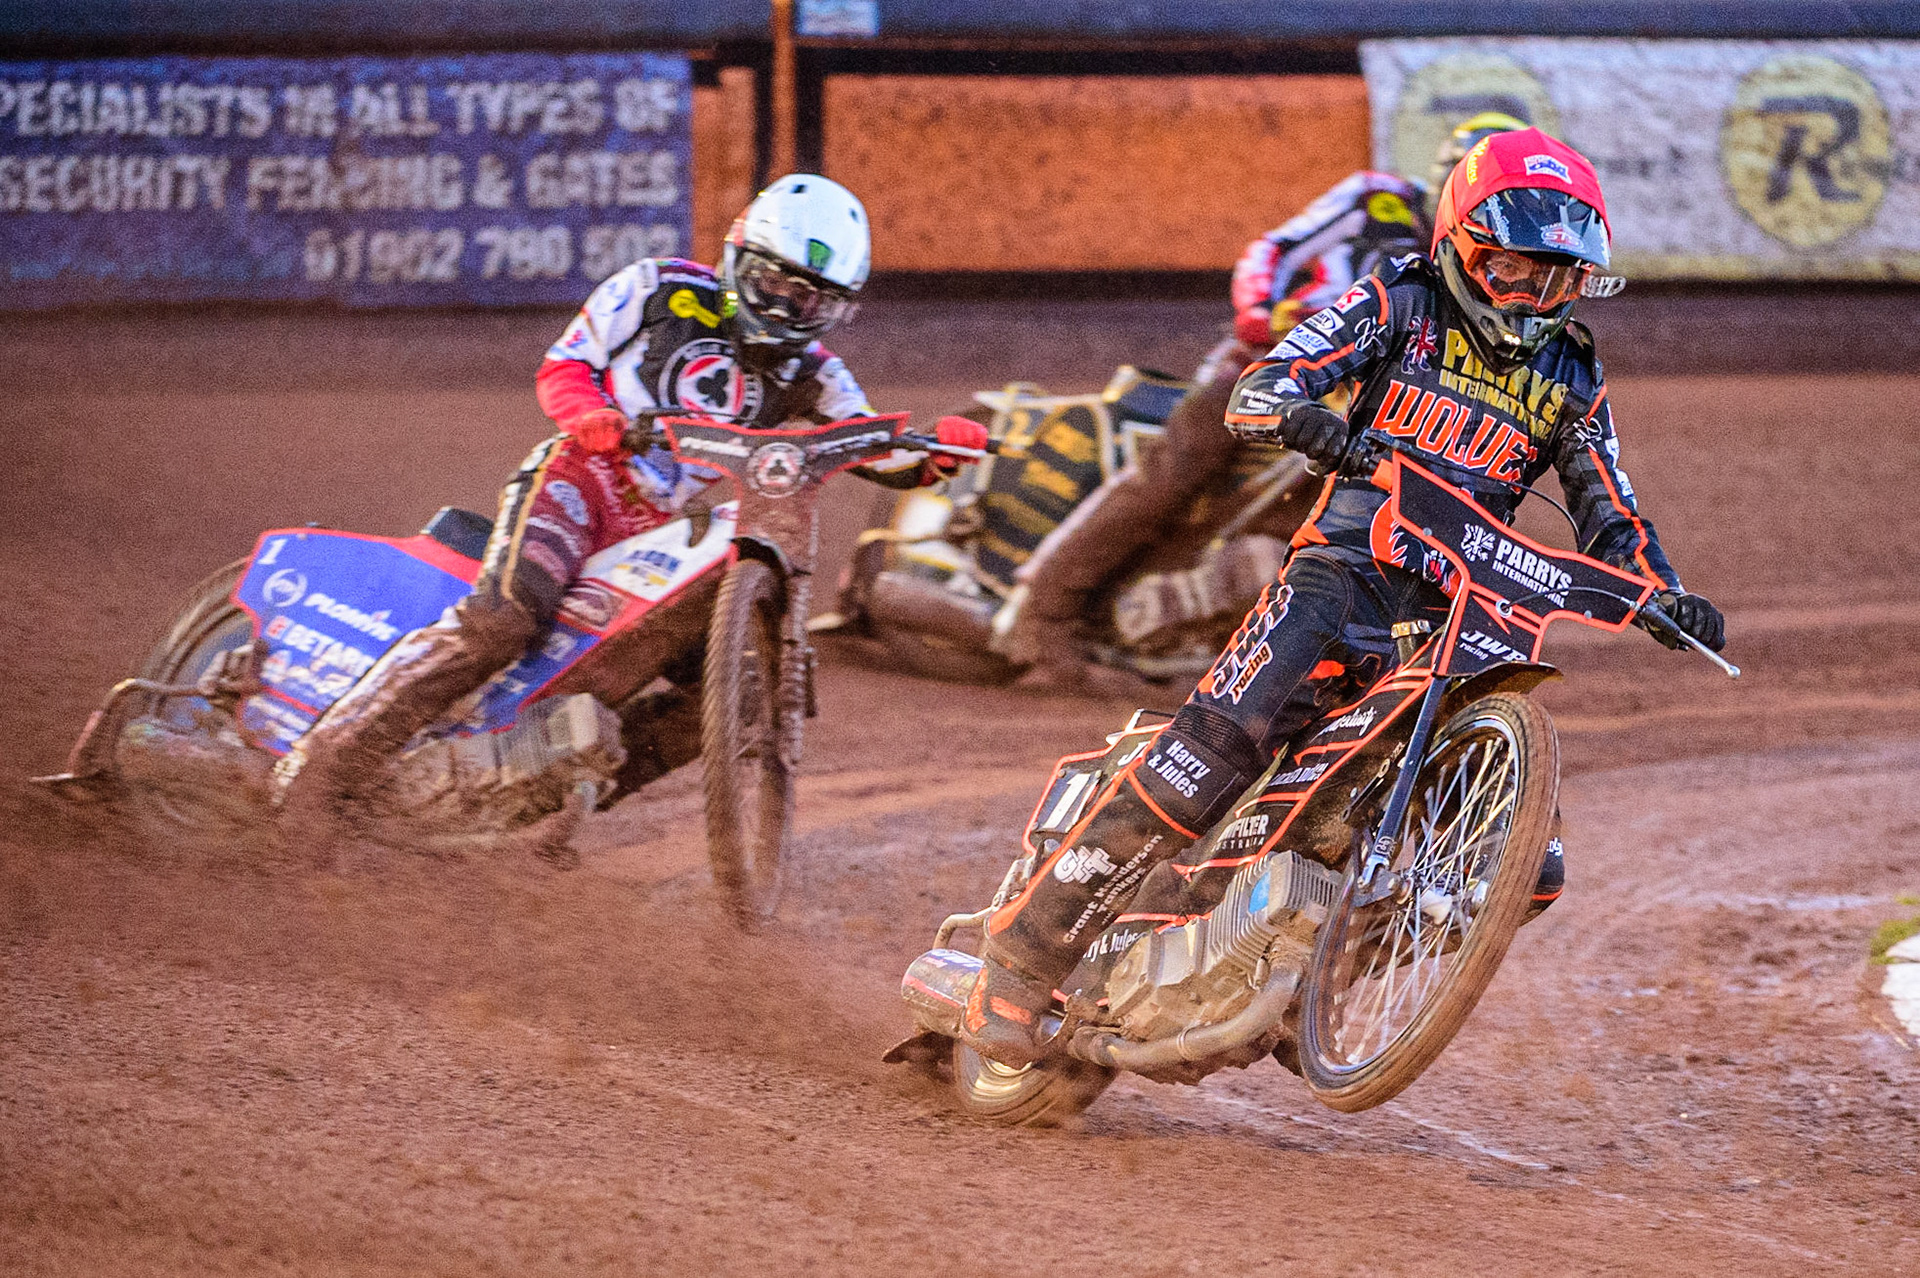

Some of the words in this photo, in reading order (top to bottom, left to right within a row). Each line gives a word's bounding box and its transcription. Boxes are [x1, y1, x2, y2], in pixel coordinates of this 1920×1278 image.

[285, 83, 336, 137] IN
[349, 83, 437, 137] ALL
[446, 82, 598, 135] TYPES
[614, 79, 680, 132] OF
[1758, 97, 1862, 203] R
[247, 154, 463, 210] FENCING
[472, 156, 512, 208] &
[527, 150, 680, 207] GATES
[1495, 538, 1573, 596] PARRYS
[1228, 641, 1273, 704] racing
[1459, 643, 1489, 660] racing
[1147, 753, 1159, 768] &
[1156, 760, 1200, 799] Jules
[1165, 739, 1211, 779] Harry
[1063, 901, 1099, 943] Grant
[1093, 834, 1164, 898] Henderson
[1096, 866, 1147, 913] Tankers
